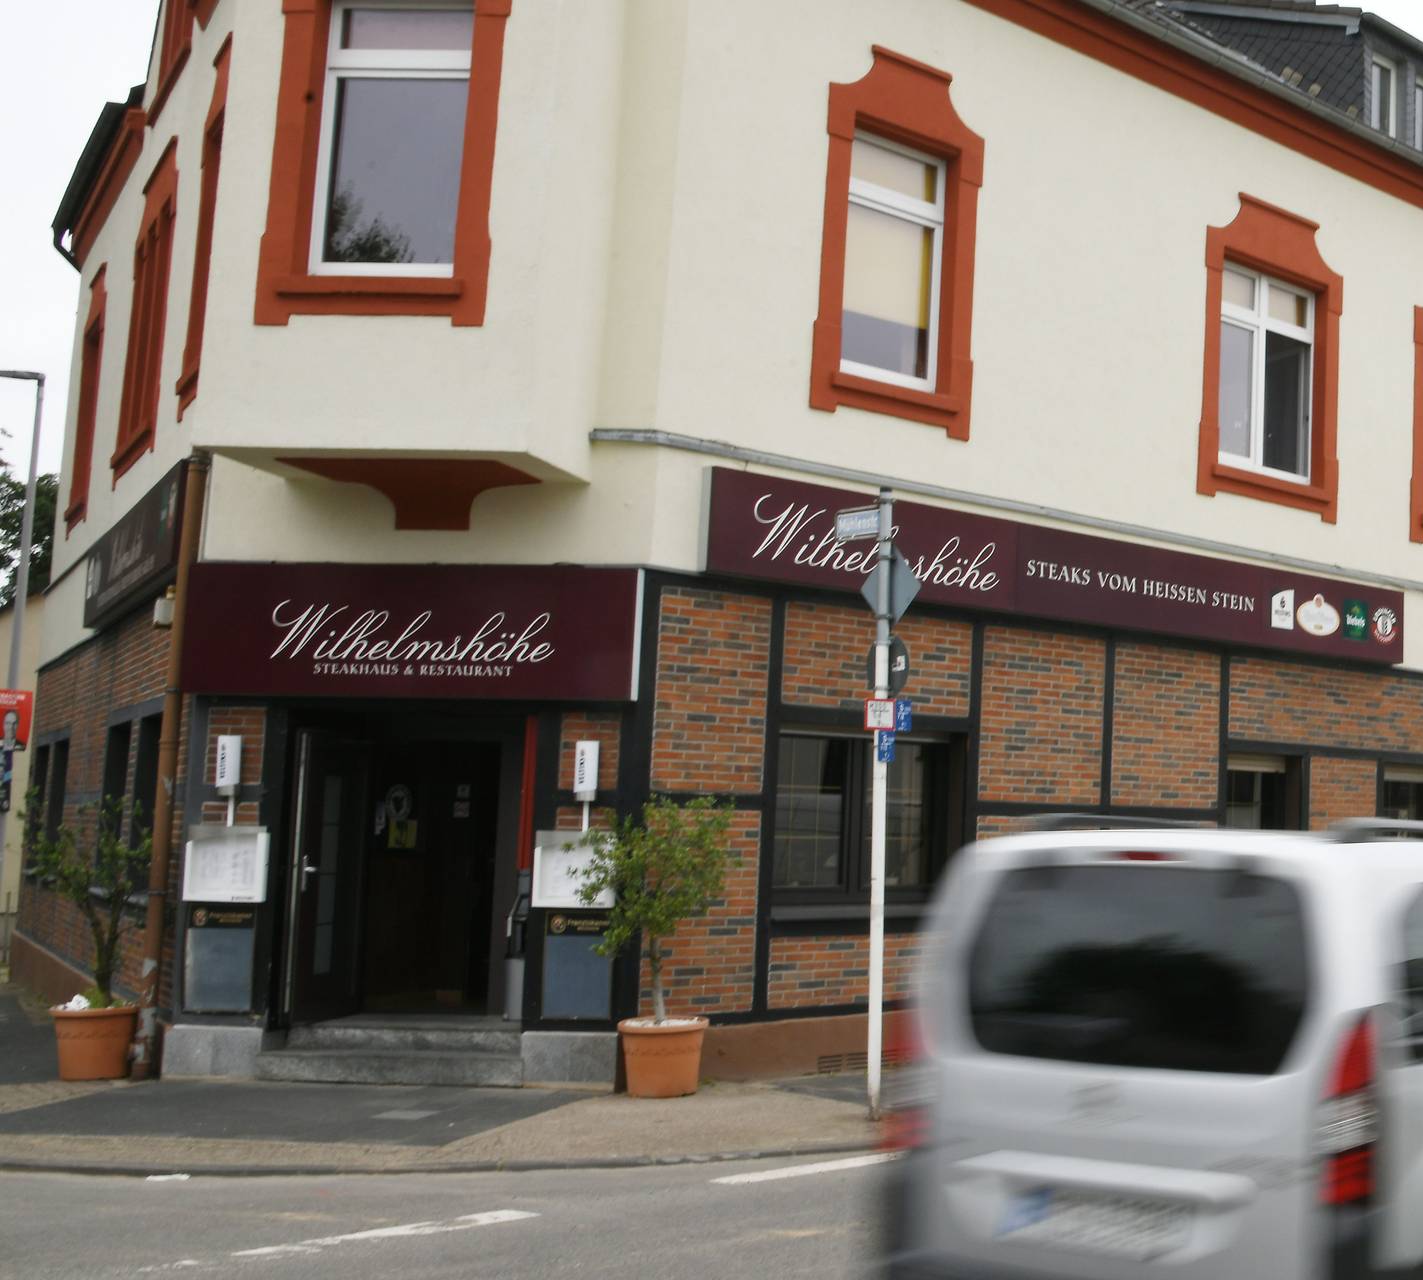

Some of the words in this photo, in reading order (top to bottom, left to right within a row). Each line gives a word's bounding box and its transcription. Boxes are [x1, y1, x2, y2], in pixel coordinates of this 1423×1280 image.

[753, 493, 1000, 592] Wilhelshöhe
[1026, 559, 1091, 586] STEAKS
[1097, 571, 1137, 593] VOM
[1143, 579, 1207, 605] HEISSEN
[1211, 591, 1255, 613] STEIN
[269, 599, 556, 663] Wilhelmshöhe
[313, 663, 399, 675] STEAKHAUS
[404, 664, 414, 675] &
[420, 664, 513, 677] RESTAURANT
